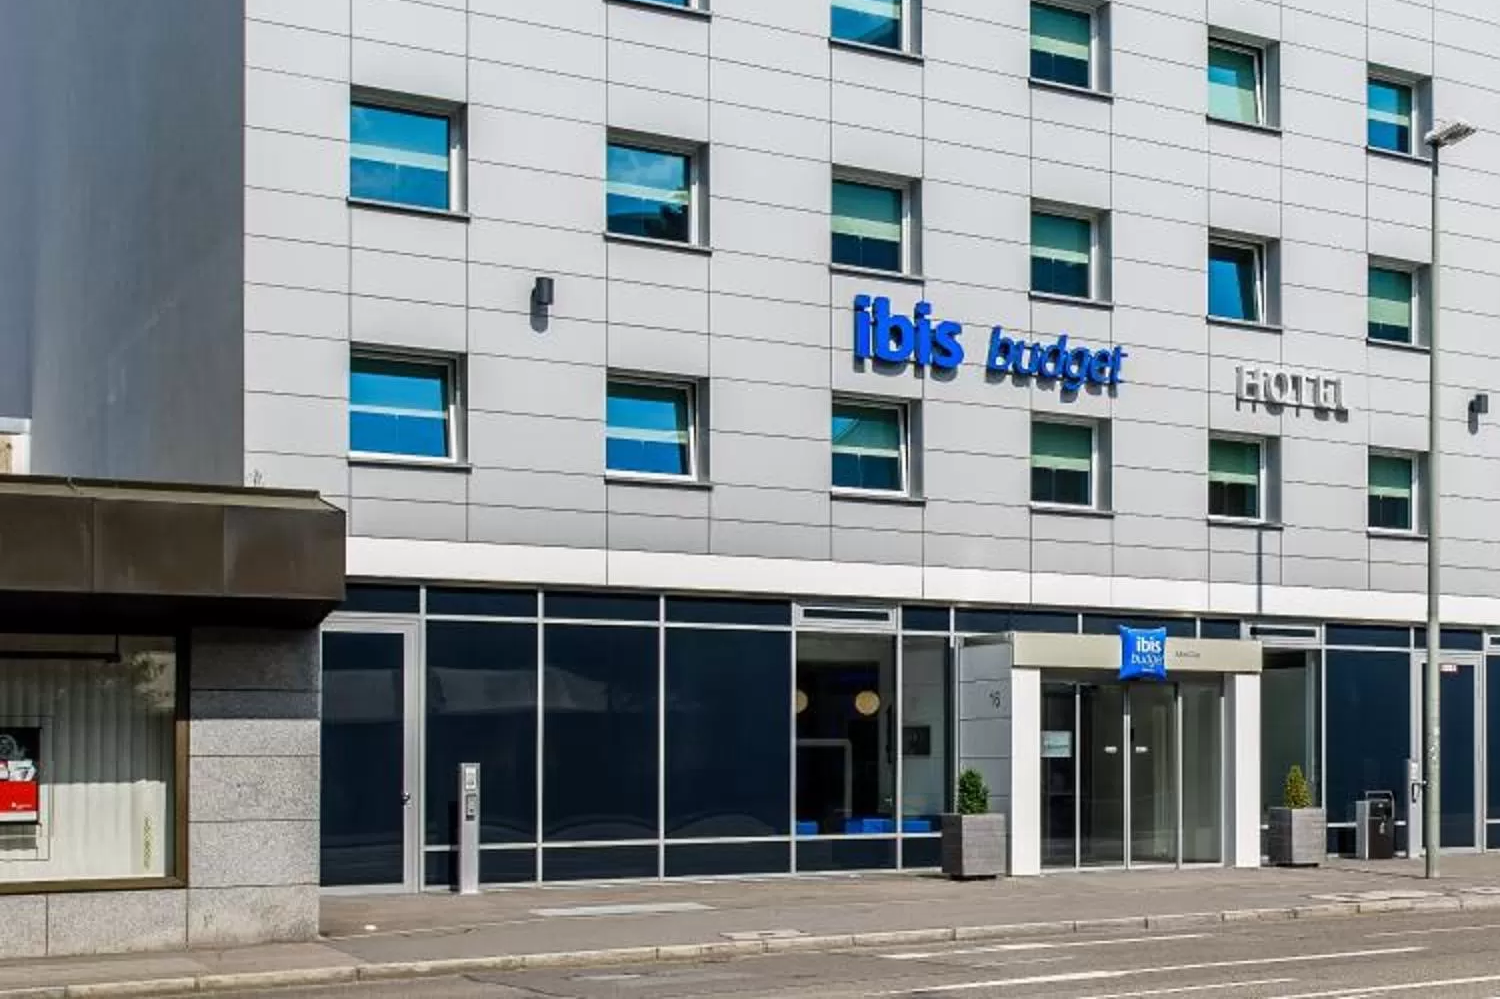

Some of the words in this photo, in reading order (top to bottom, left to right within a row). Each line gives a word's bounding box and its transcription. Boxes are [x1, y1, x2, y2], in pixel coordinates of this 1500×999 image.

[854, 294, 964, 369] ibis
[986, 325, 1128, 391] budget
[1235, 366, 1350, 411] HOTEL
[1136, 635, 1162, 654] ibis
